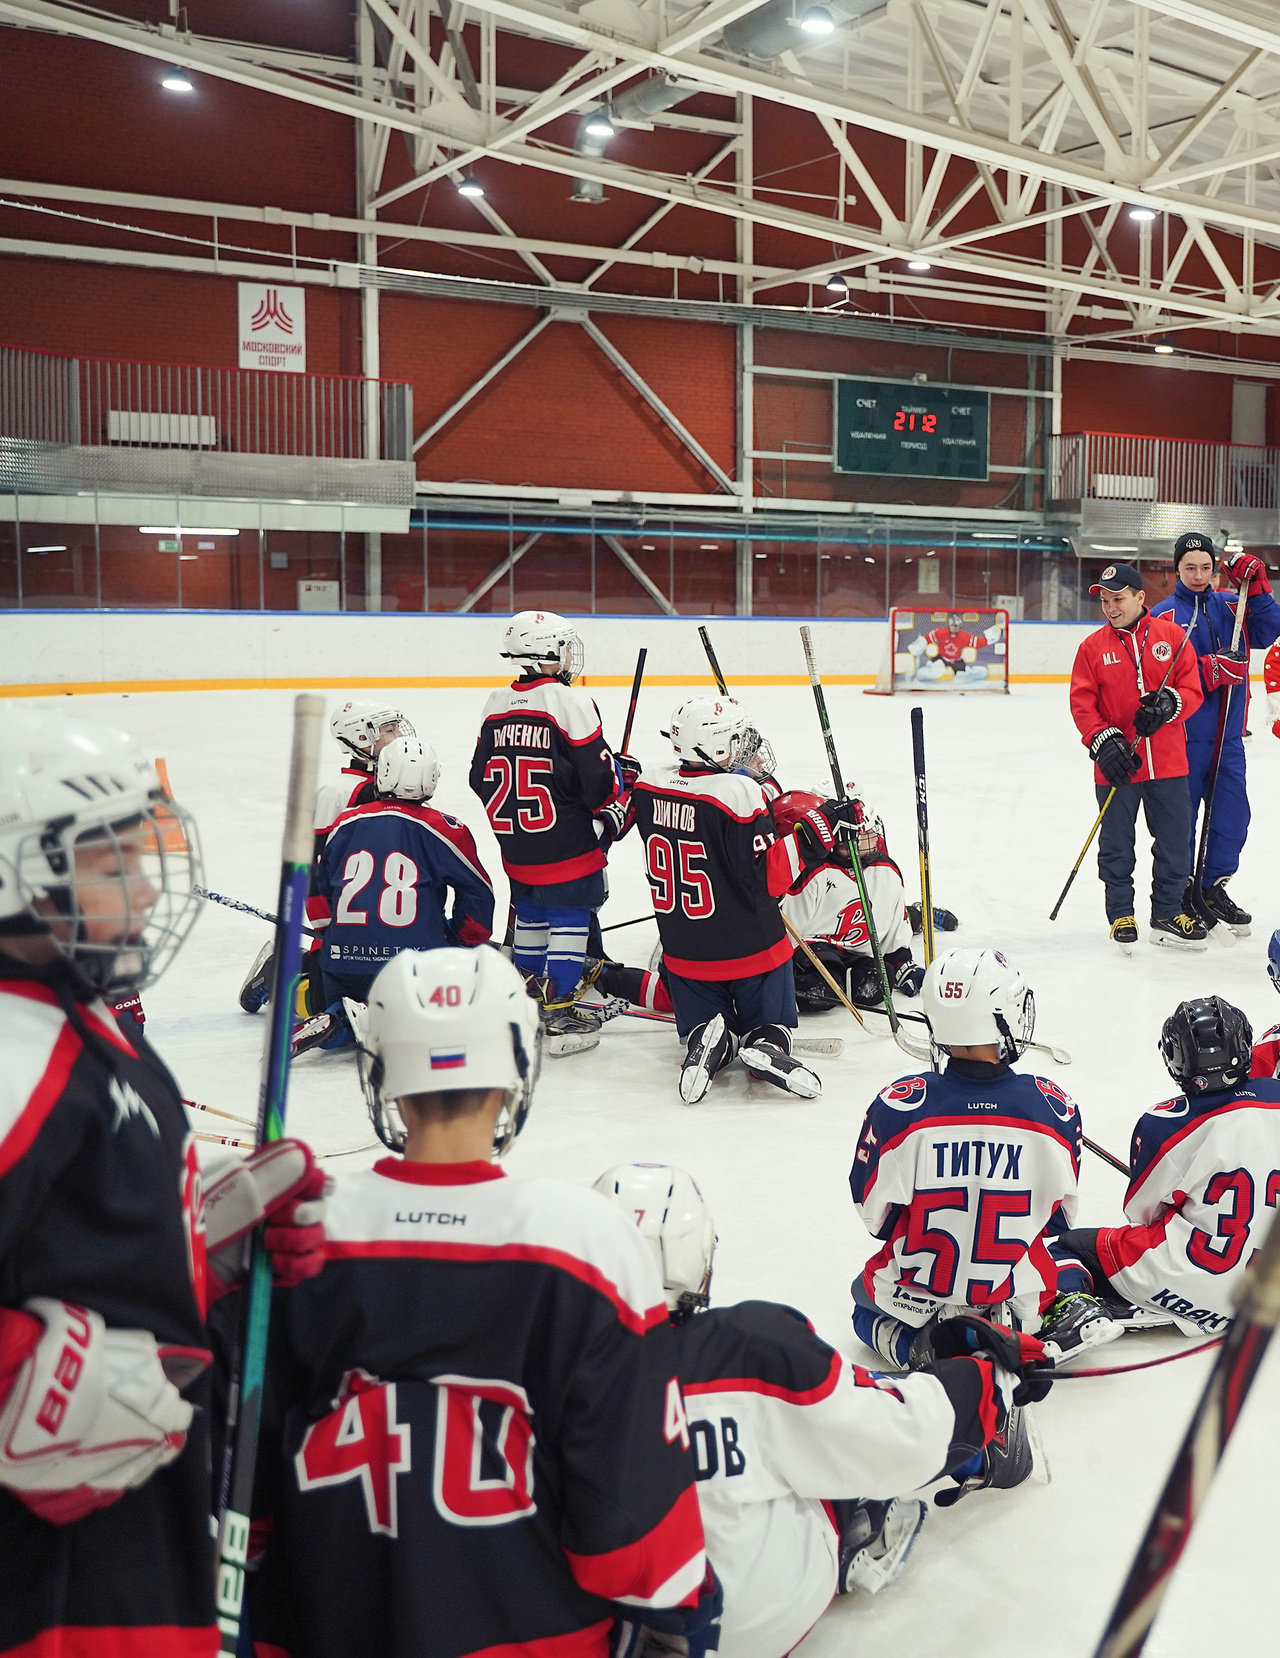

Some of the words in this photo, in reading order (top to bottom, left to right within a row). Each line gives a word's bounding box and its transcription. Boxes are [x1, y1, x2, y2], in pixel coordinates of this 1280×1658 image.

[242, 340, 303, 355] МОСКОВСКИЙ
[258, 355, 286, 367] СПОРТ
[1102, 651, 1122, 666] M.L.
[483, 755, 558, 835] 25
[652, 798, 695, 833] ШИНОВ
[647, 833, 715, 920] 95
[336, 849, 420, 928] 28
[342, 945, 421, 956] SPINETX
[428, 985, 461, 1008] 40
[944, 982, 963, 998] 55
[967, 1101, 997, 1110] LUTCH
[932, 1141, 1023, 1181] ТИТУХ
[394, 1212, 467, 1227] LUTCH
[901, 1186, 1032, 1306] 55
[893, 1301, 923, 1314] ОТКРЫТОЕ
[294, 1369, 538, 1538] 40
